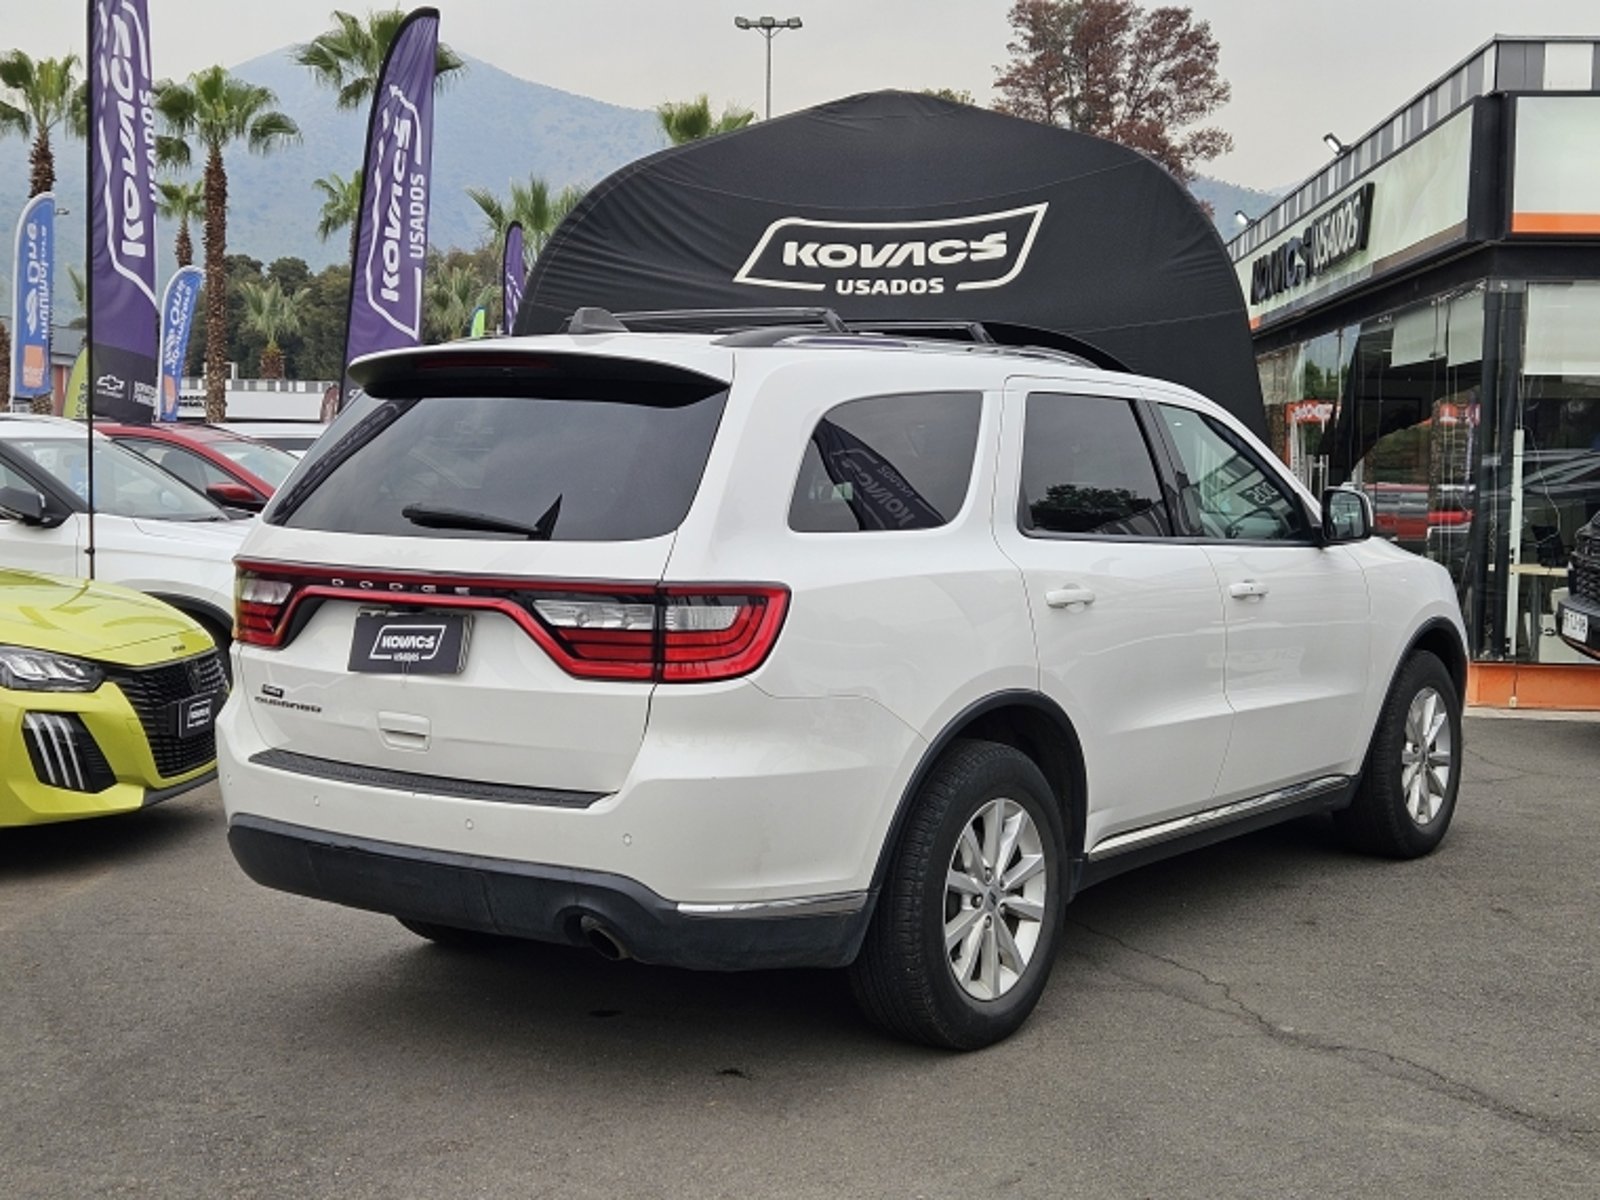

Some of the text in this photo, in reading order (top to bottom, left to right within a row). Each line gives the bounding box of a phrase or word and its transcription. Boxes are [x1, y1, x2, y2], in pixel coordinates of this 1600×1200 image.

[381, 117, 411, 302] KOVACS
[410, 173, 425, 258] USADOS
[782, 231, 1007, 268] KOVACS
[835, 277, 944, 296] USADOS
[331, 578, 470, 596] DODGE
[381, 635, 435, 649] KOVACS
